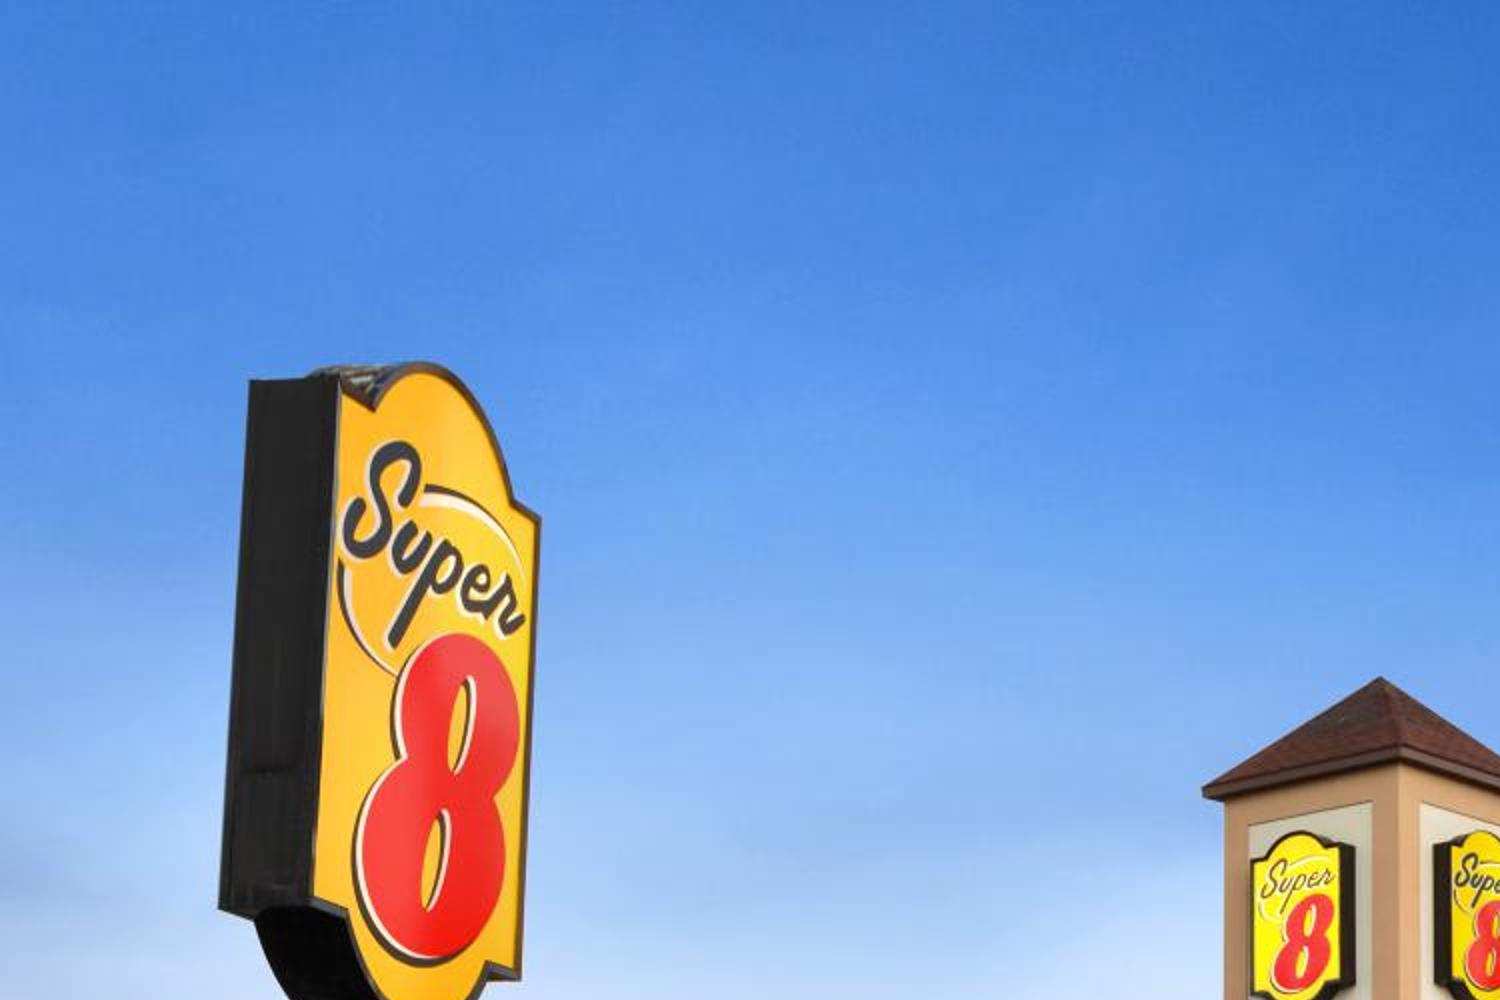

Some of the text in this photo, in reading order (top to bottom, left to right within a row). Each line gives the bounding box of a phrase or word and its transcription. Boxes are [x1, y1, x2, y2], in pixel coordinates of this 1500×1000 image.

[341, 440, 526, 650] Super
[353, 632, 520, 967] 8
[1260, 857, 1335, 914] Super
[1270, 893, 1335, 992] 8
